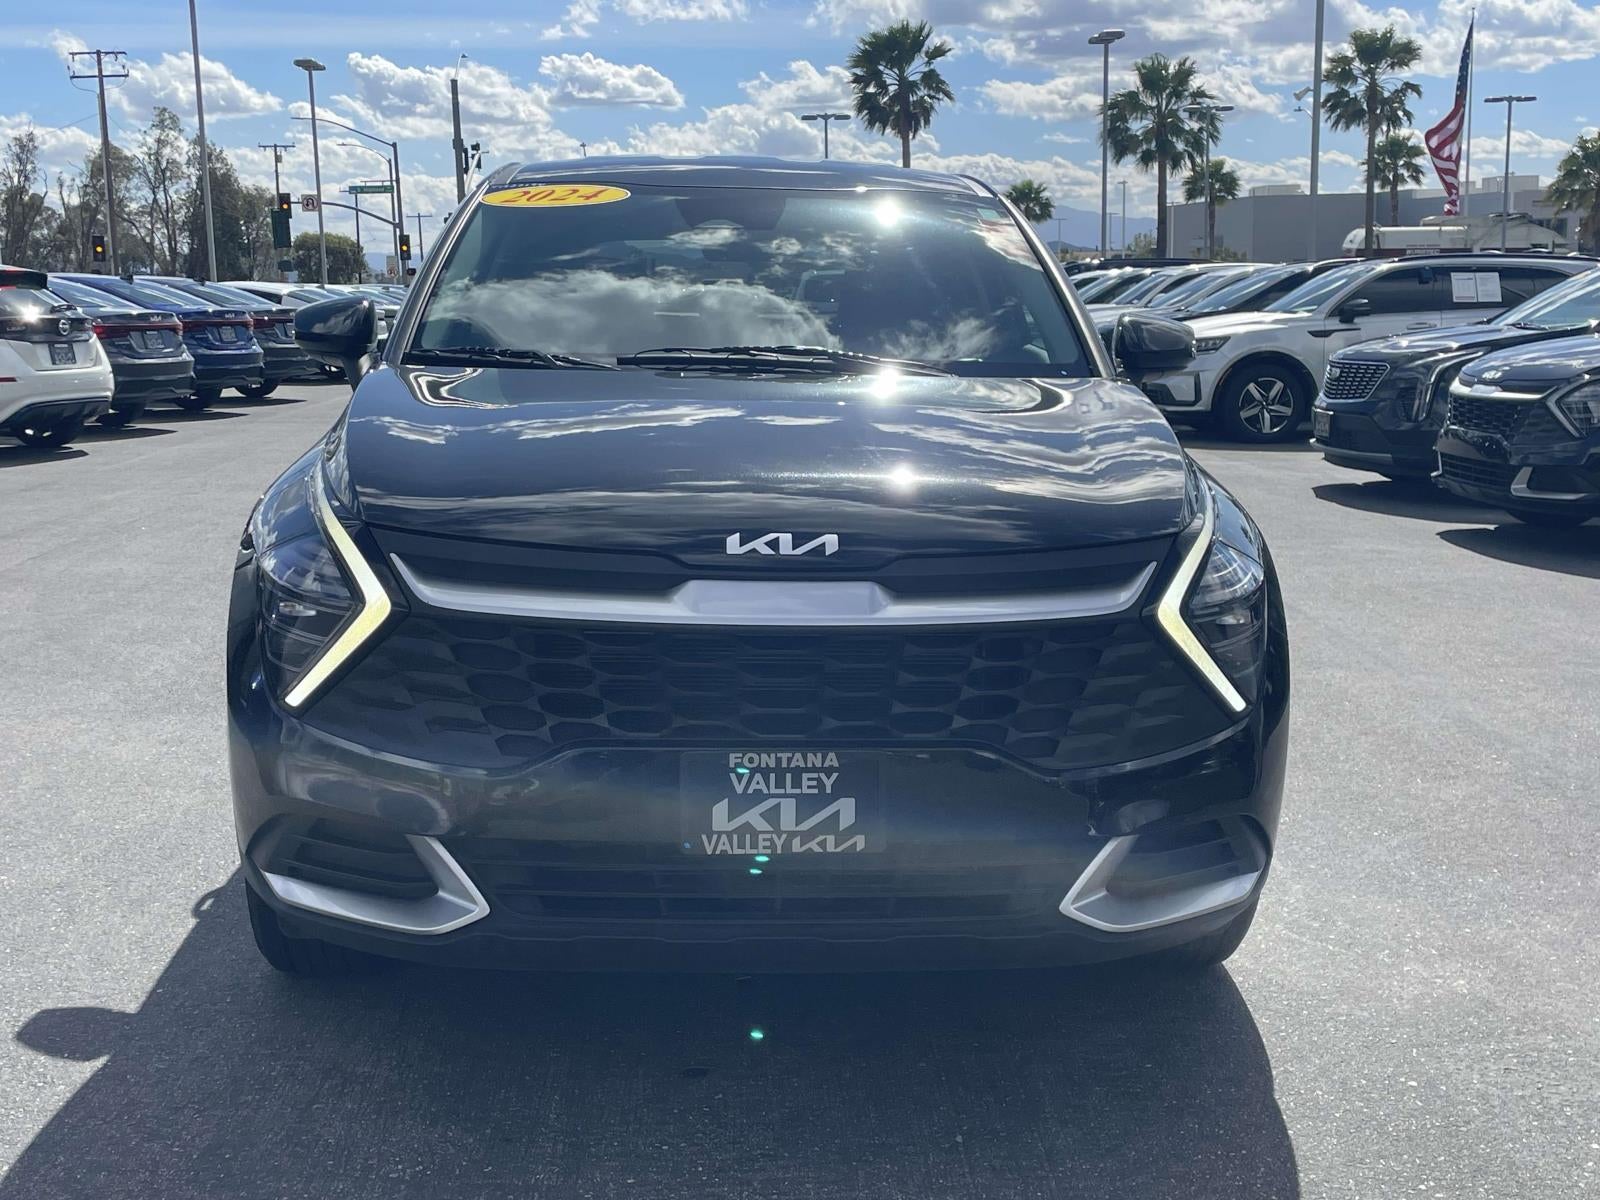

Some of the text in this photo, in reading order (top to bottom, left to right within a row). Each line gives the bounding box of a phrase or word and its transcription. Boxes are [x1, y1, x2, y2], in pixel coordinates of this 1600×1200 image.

[502, 188, 609, 203] 2024
[726, 532, 839, 556] KIA
[729, 752, 839, 768] FONTANA
[729, 773, 839, 794] VALLEY
[712, 797, 856, 831] KIA
[701, 834, 866, 855] VALLEY KIA
